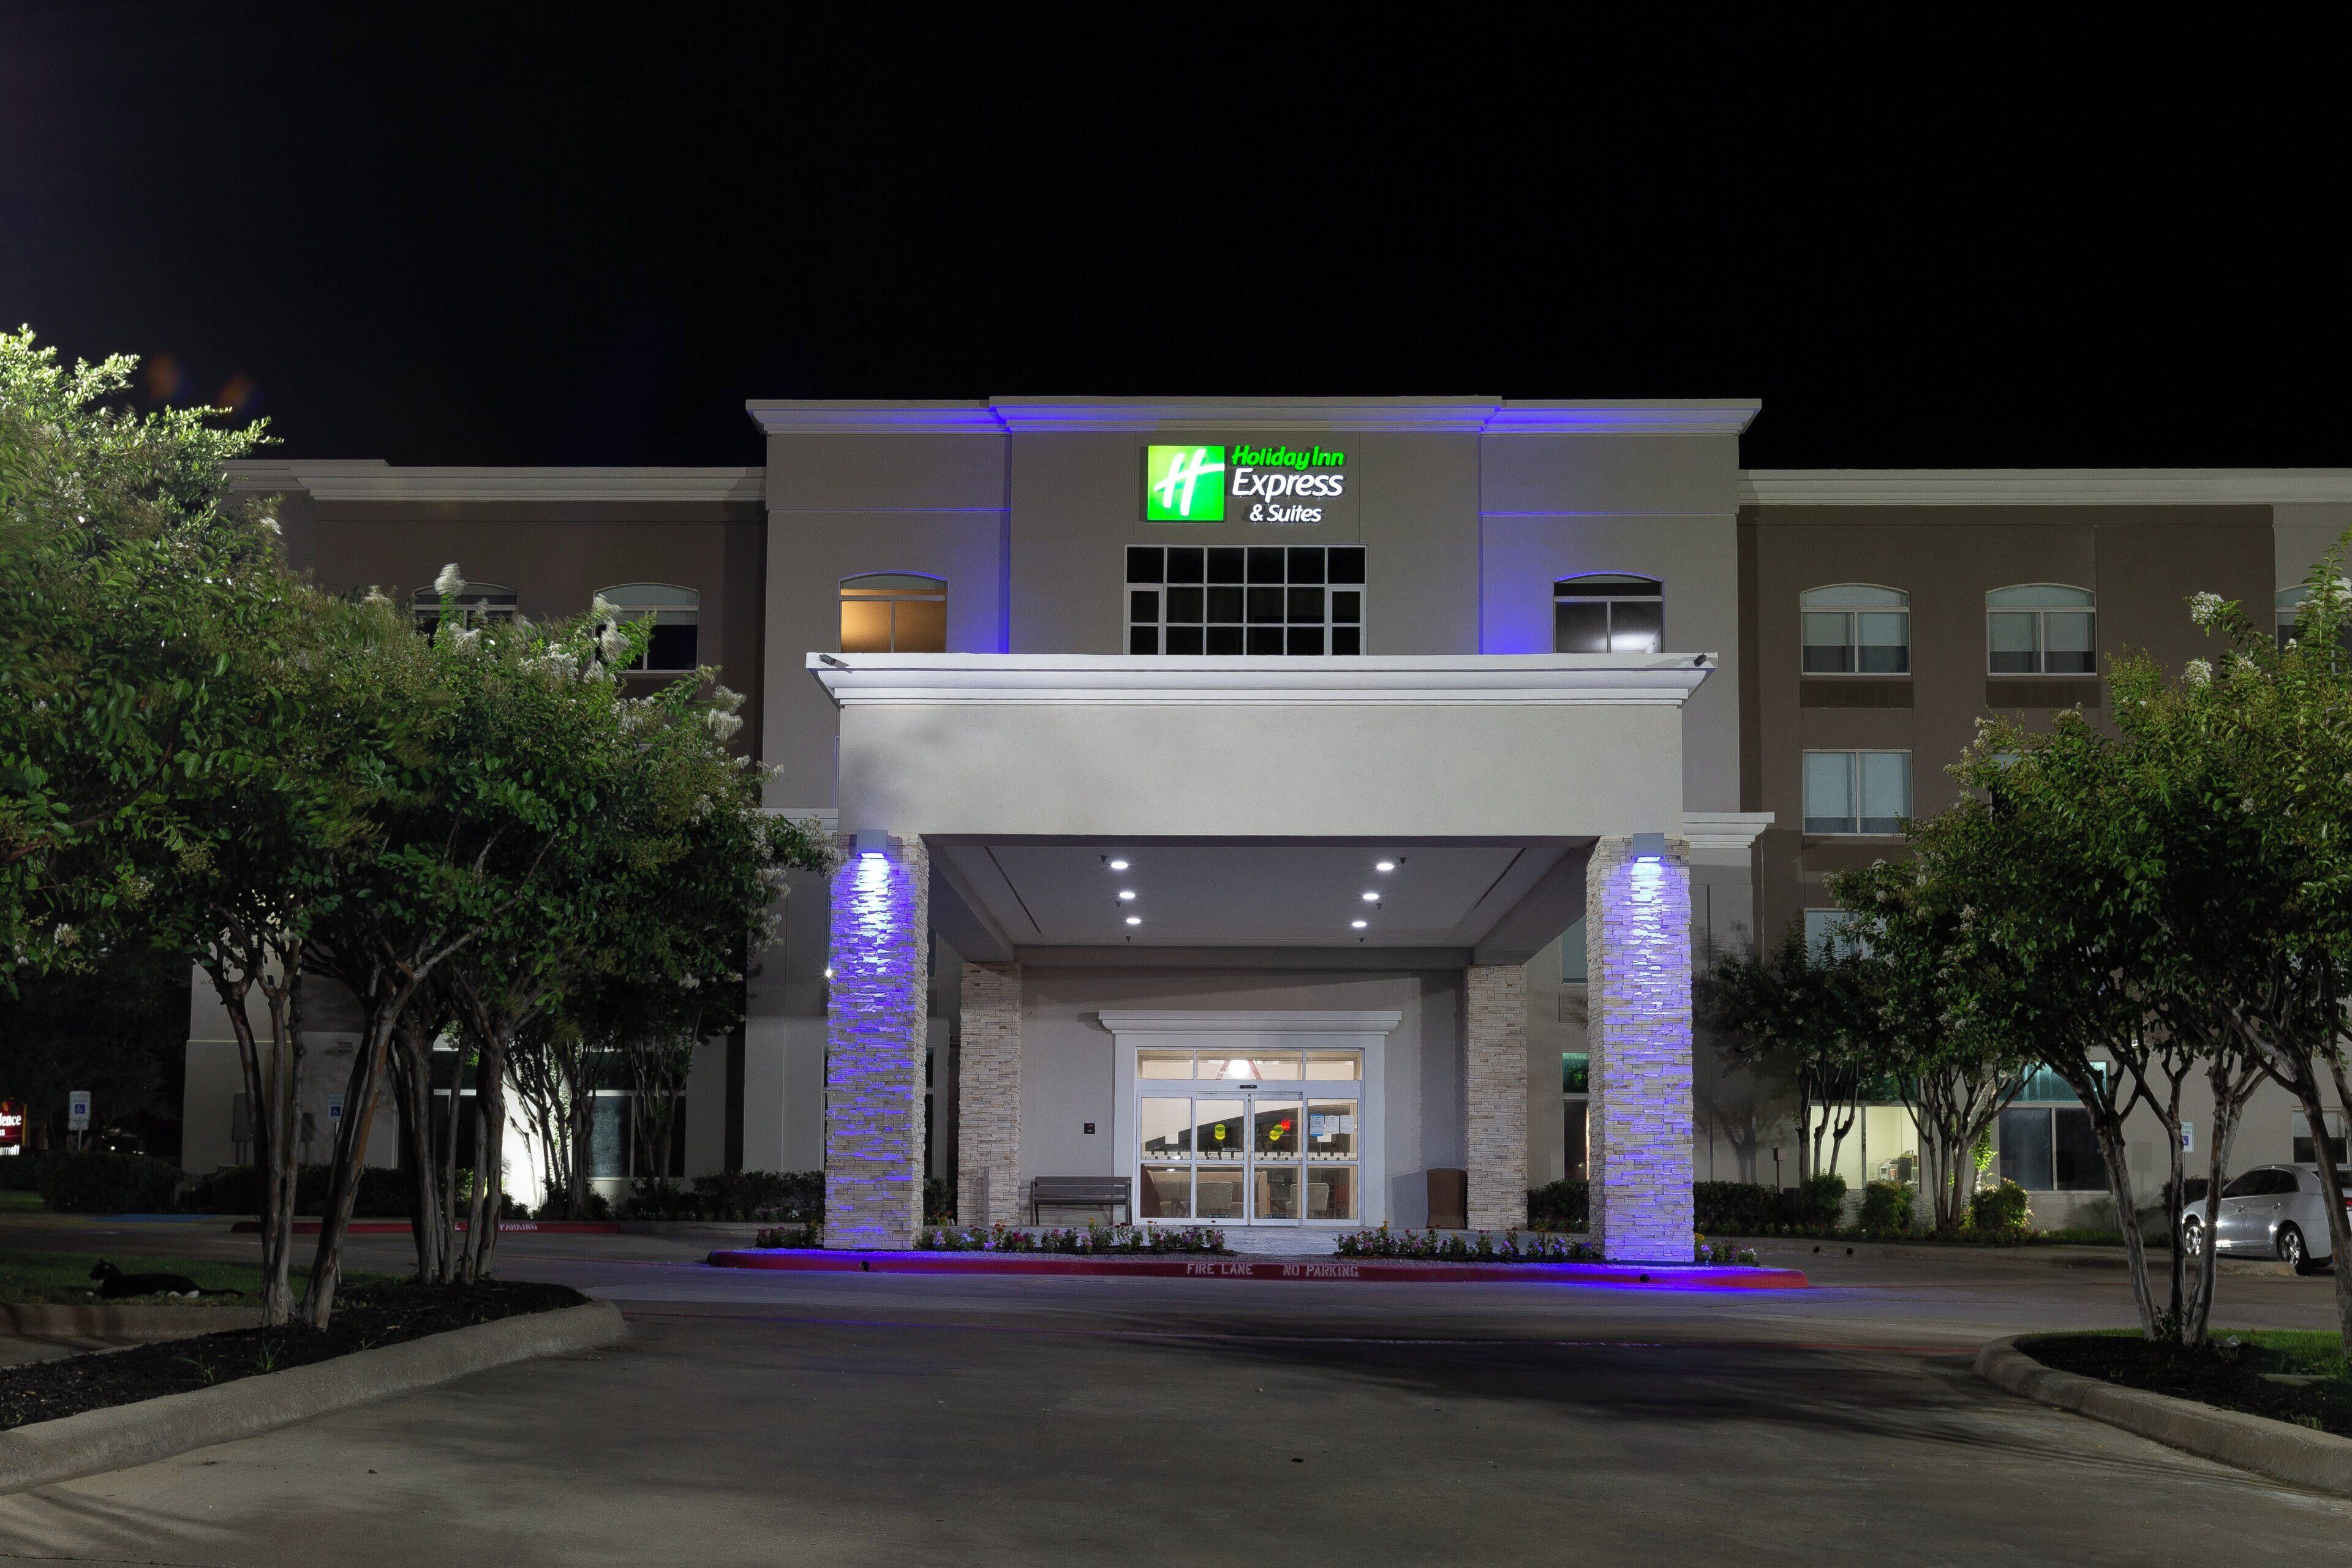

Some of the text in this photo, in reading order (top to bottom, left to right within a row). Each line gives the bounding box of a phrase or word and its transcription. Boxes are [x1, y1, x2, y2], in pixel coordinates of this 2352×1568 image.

[1231, 445, 1344, 470] Holiday Inn
[1232, 467, 1344, 503] Express
[1250, 503, 1322, 522] & Suites
[1187, 1264, 1359, 1277] FIRE LANE NO PARKING
